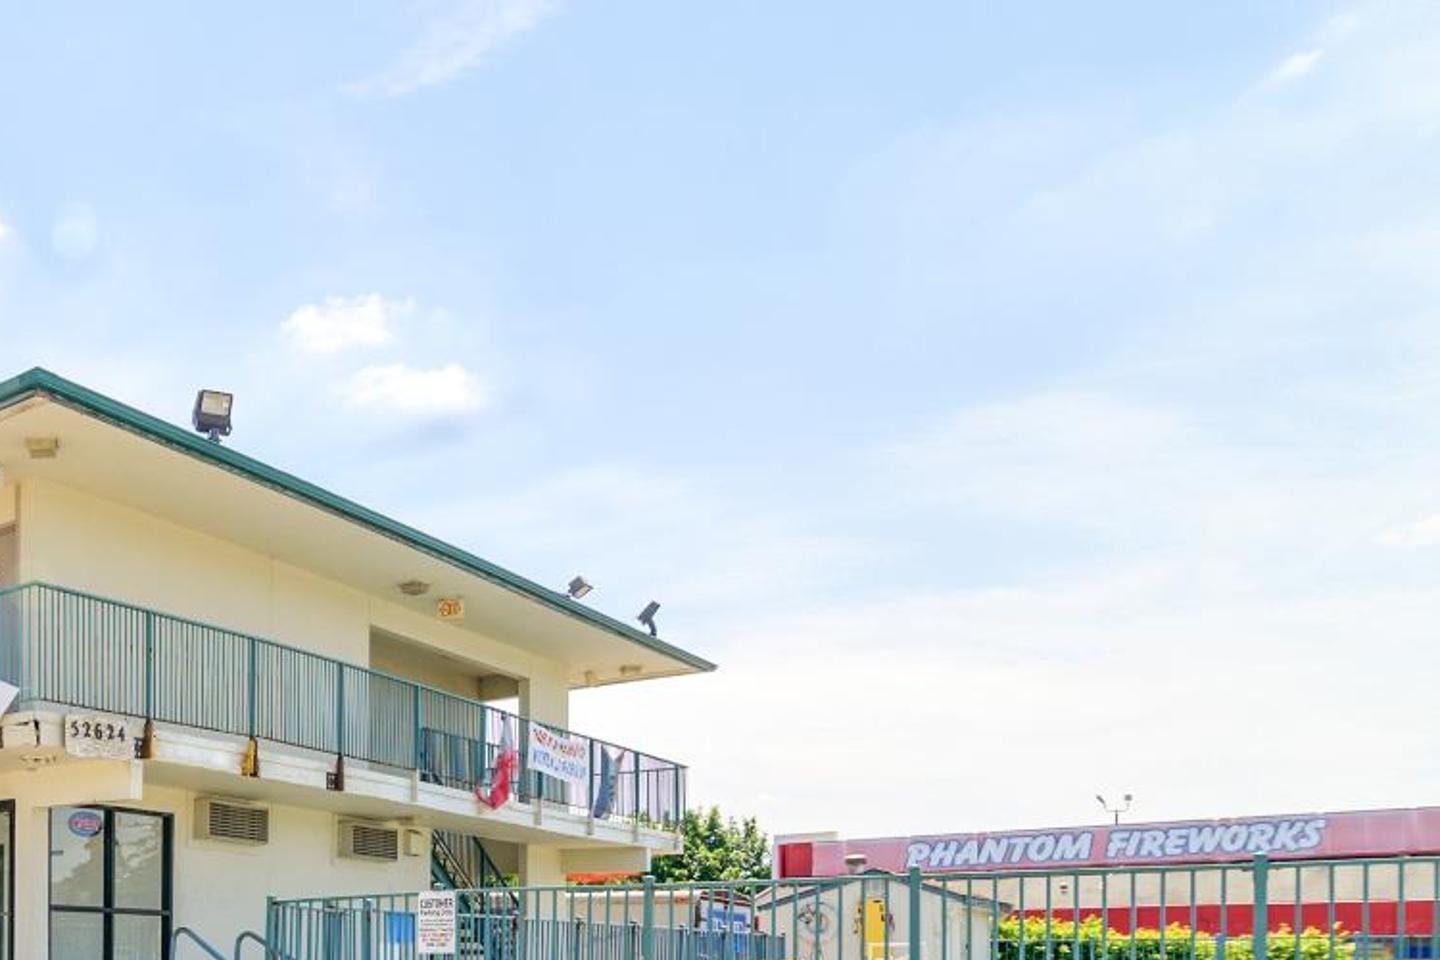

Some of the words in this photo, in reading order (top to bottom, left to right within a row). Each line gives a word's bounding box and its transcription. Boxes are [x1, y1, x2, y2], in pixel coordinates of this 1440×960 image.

[70, 720, 126, 742] 52624
[906, 831, 1092, 869] PHANTOM
[1106, 818, 1326, 858] FIREWORKS
